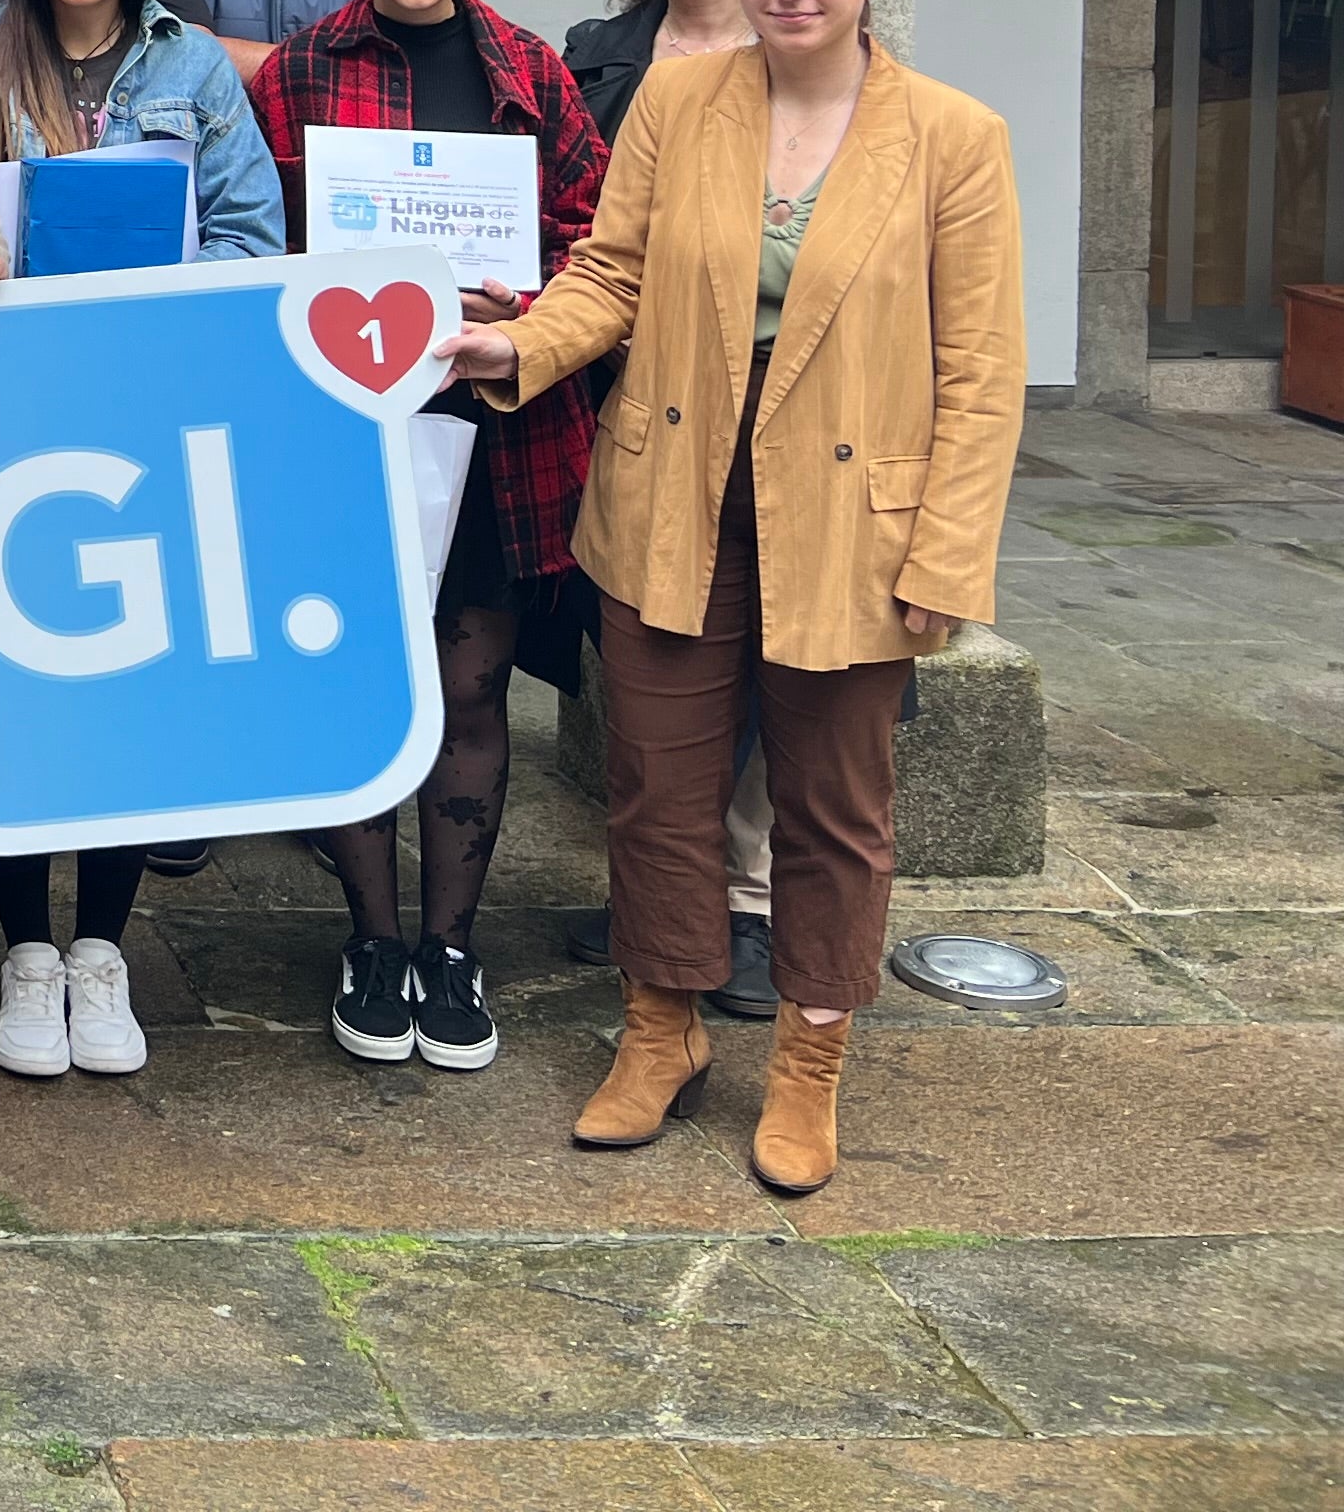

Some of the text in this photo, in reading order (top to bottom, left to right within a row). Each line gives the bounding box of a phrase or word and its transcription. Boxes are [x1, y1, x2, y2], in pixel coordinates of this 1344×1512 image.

[390, 196, 515, 220] Lingua de
[357, 319, 386, 365] 1
